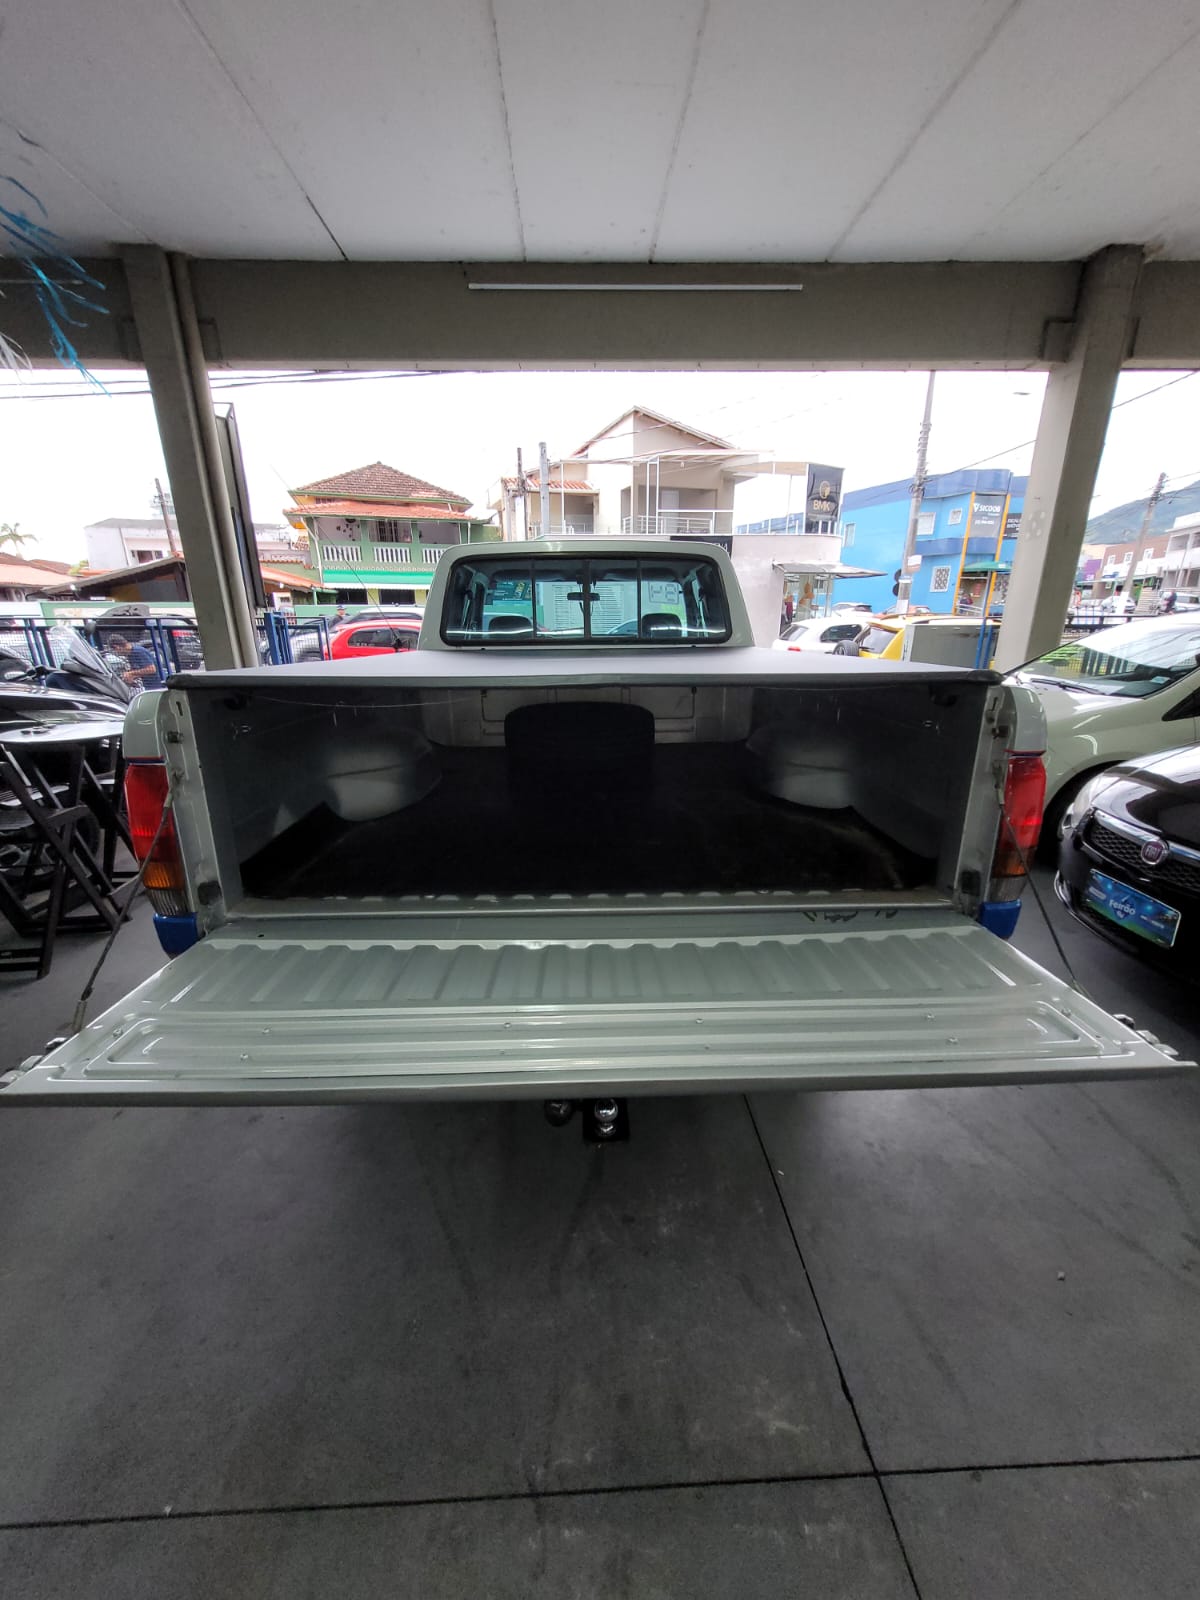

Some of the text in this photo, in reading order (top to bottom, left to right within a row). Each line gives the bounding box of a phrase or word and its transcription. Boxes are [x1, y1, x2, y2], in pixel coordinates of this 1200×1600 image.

[813, 500, 830, 511] BMK
[979, 504, 1001, 513] SICOOB
[1145, 845, 1160, 860] FIAT
